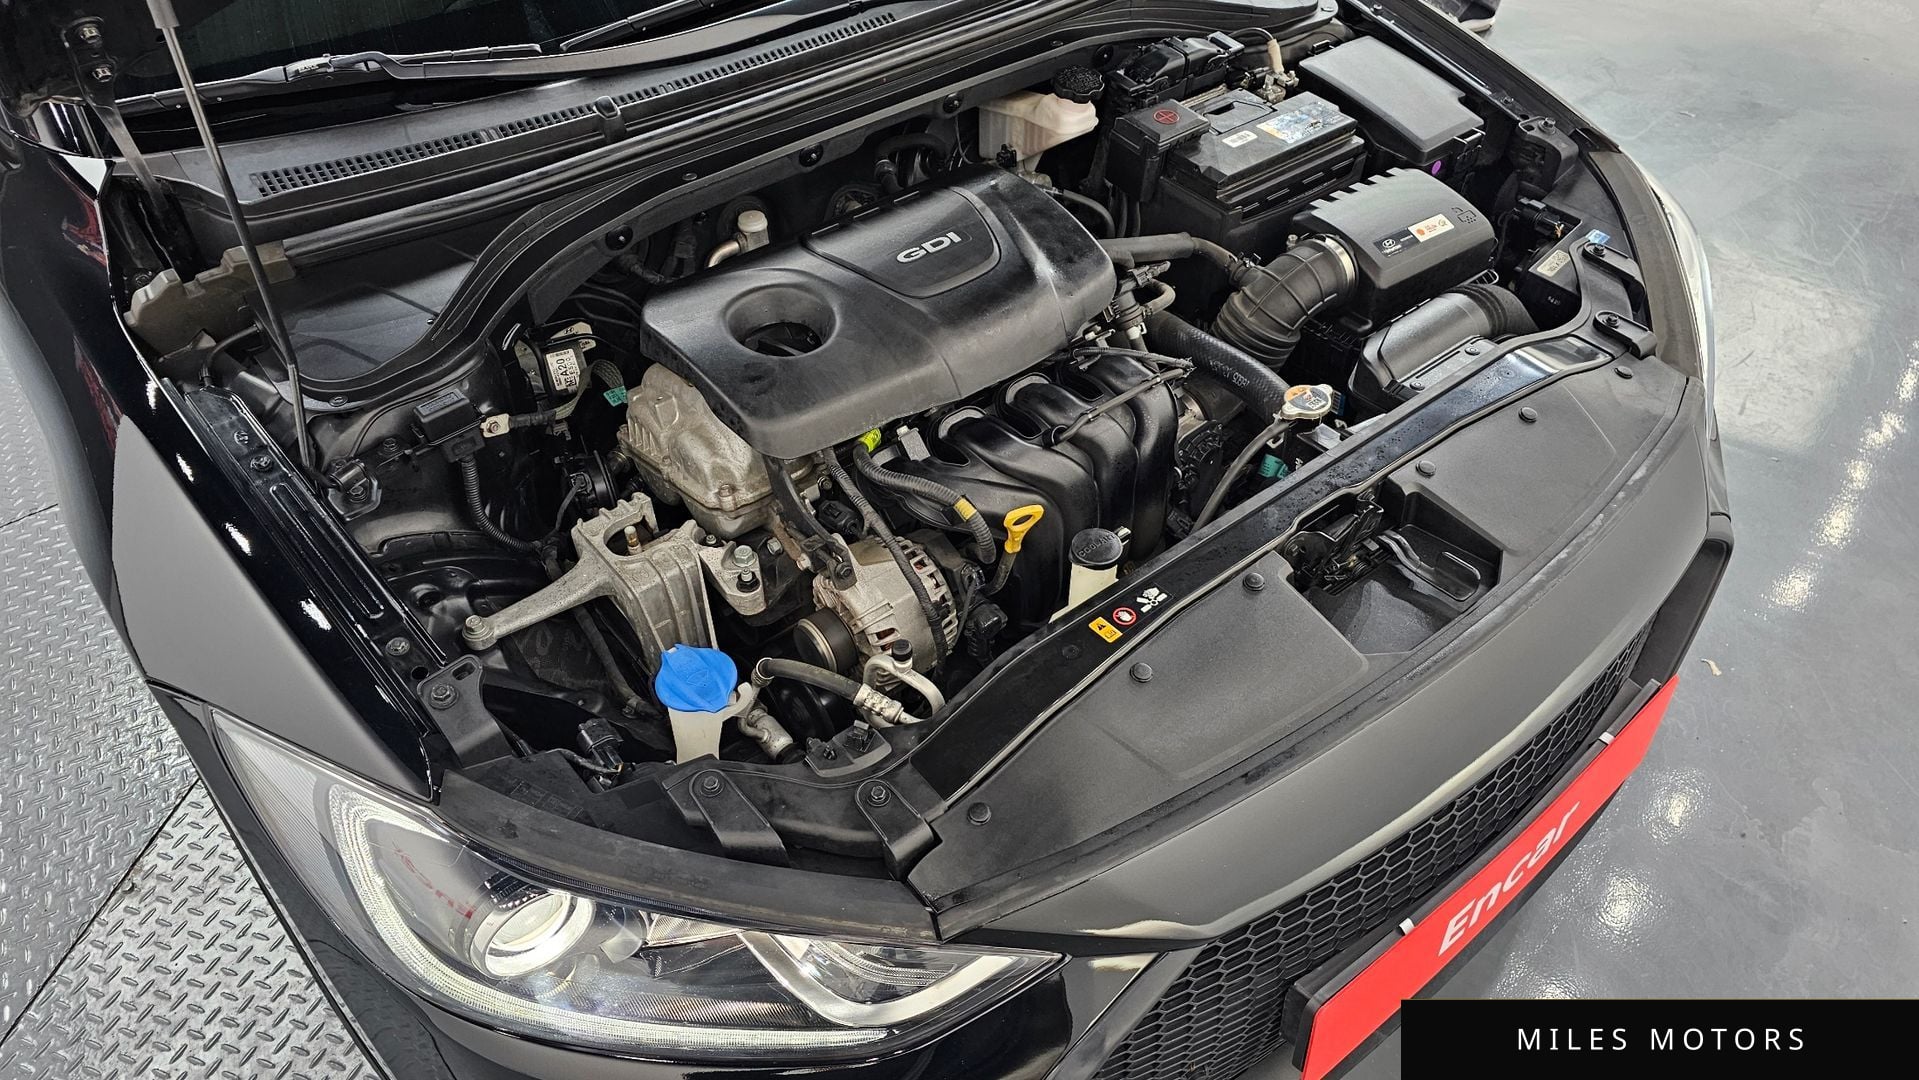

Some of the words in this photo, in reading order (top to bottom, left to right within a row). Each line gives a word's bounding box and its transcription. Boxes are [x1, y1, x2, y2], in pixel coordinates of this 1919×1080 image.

[896, 231, 962, 263] GDI
[556, 358, 568, 377] A20
[1078, 533, 1116, 557] COOLANT
[1438, 801, 1580, 957] Encar
